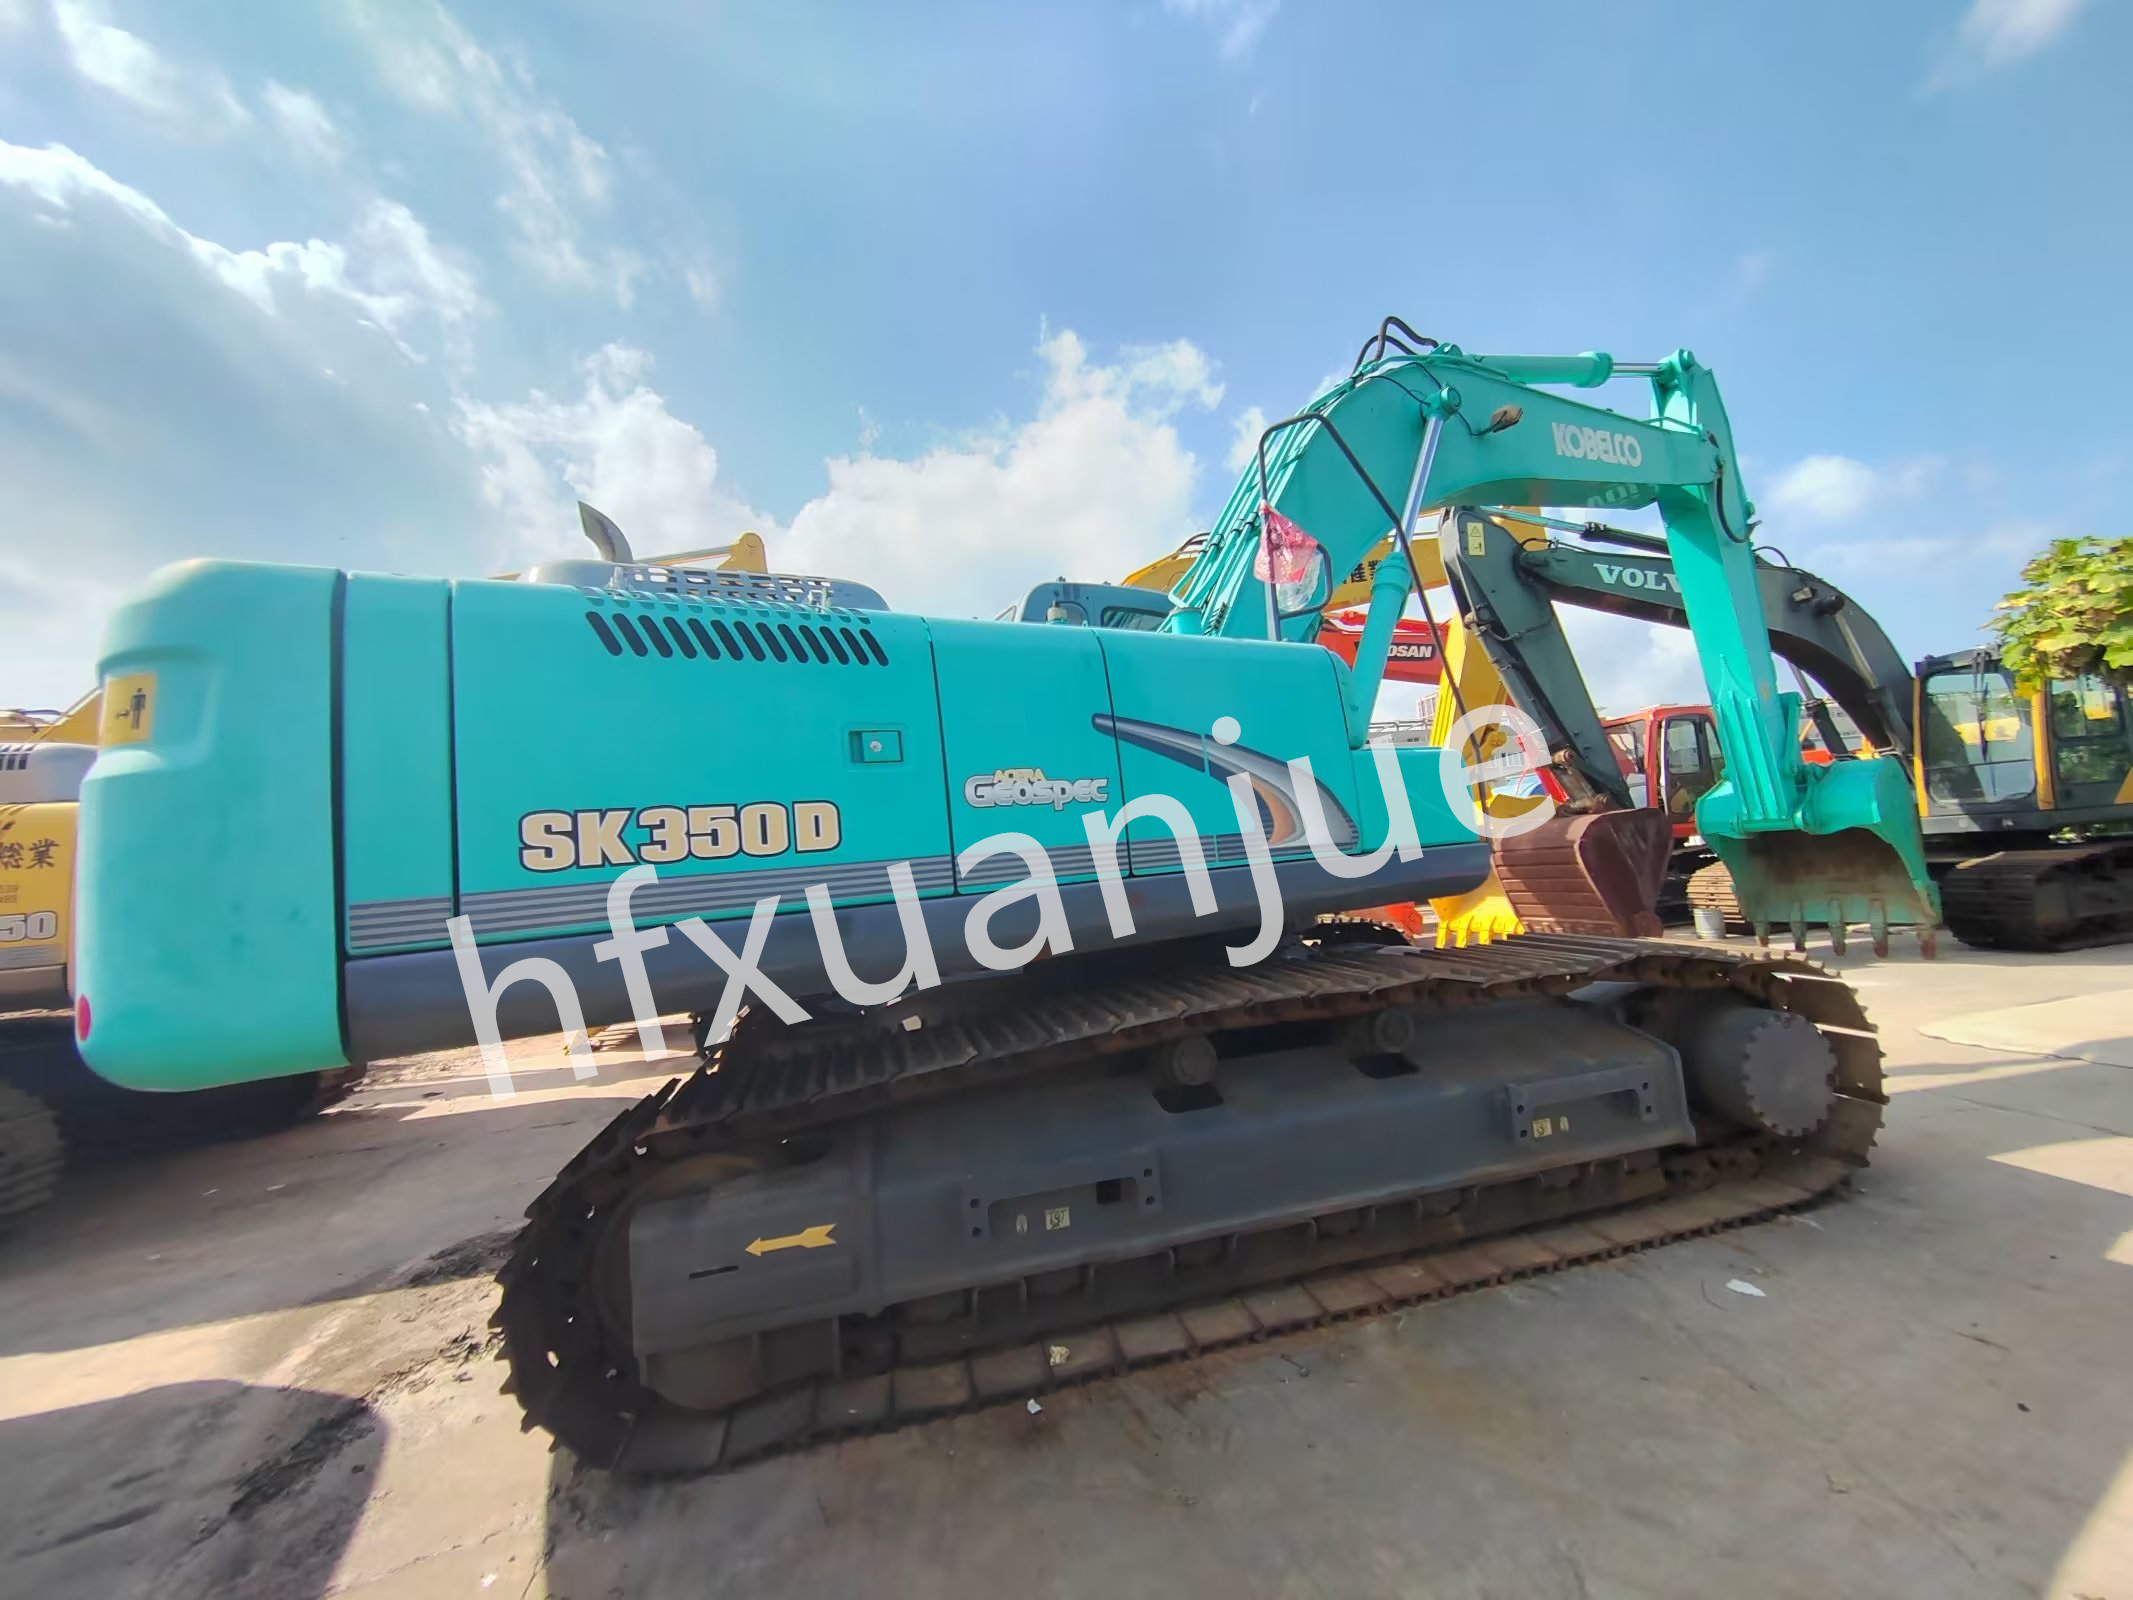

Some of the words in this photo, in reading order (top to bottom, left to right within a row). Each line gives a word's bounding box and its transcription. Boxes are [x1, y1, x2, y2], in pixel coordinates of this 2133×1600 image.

[1552, 422, 1643, 467] KOBELCO
[1593, 563, 1683, 593] VOLV
[1387, 644, 1433, 658] OSAN
